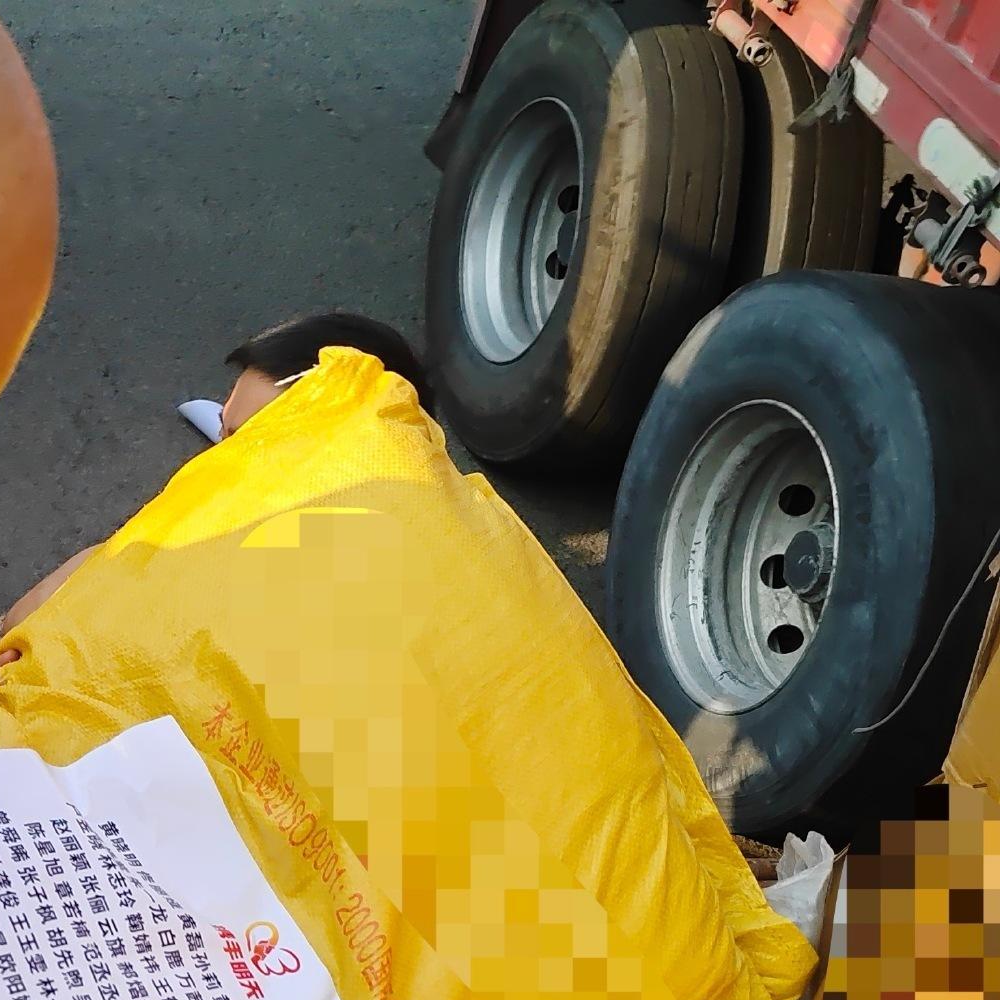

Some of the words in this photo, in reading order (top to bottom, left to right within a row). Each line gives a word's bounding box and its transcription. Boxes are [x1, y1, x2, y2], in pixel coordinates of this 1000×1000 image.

[16, 865, 58, 925] 张子枫
[45, 927, 84, 990] 胡先煦
[23, 821, 65, 877] 陈星旭
[53, 880, 92, 939] 章若楠
[49, 818, 91, 872] 赵丽颖
[78, 874, 111, 915] 张俪
[97, 917, 128, 958] 云旗
[97, 850, 136, 908] 林志玲
[97, 820, 142, 873] 黄晓明
[176, 913, 222, 991] 黄磊孙莉
[7, 912, 48, 975] 王玉雯
[157, 928, 185, 970] 白鹿
